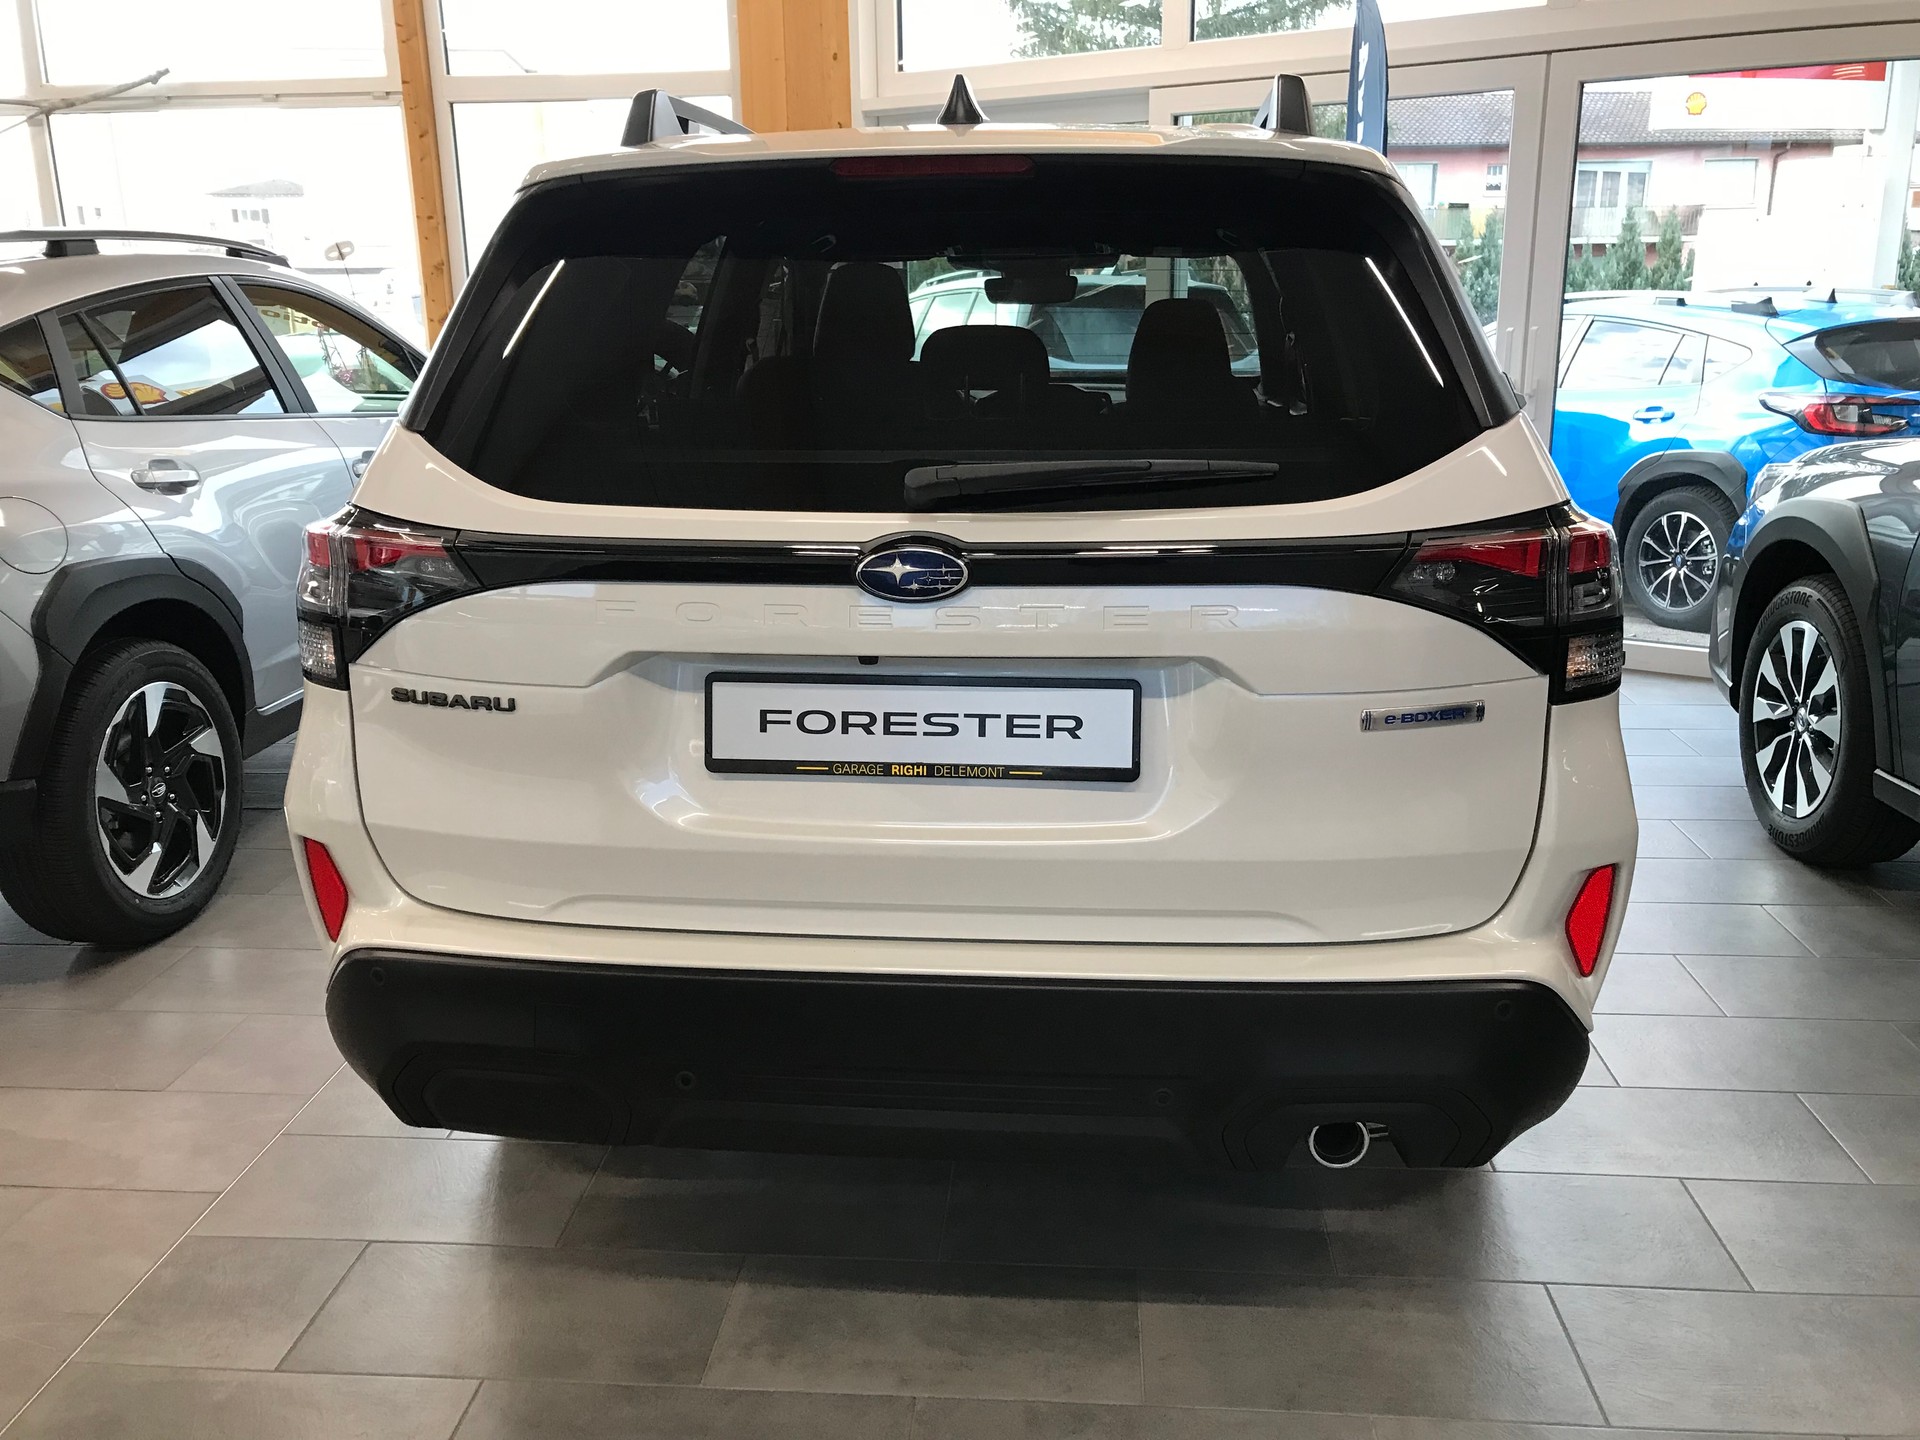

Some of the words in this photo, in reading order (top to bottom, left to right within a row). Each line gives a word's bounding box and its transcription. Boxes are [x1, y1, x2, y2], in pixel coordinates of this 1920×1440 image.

[596, 600, 1240, 631] FORESTER
[391, 686, 517, 713] SUBARU
[758, 708, 1085, 741] FORESTER
[1384, 707, 1466, 725] e-BOXER
[832, 763, 884, 776] GARAGE
[891, 764, 927, 776] RIGHI
[934, 765, 1006, 778] DELEMONT
